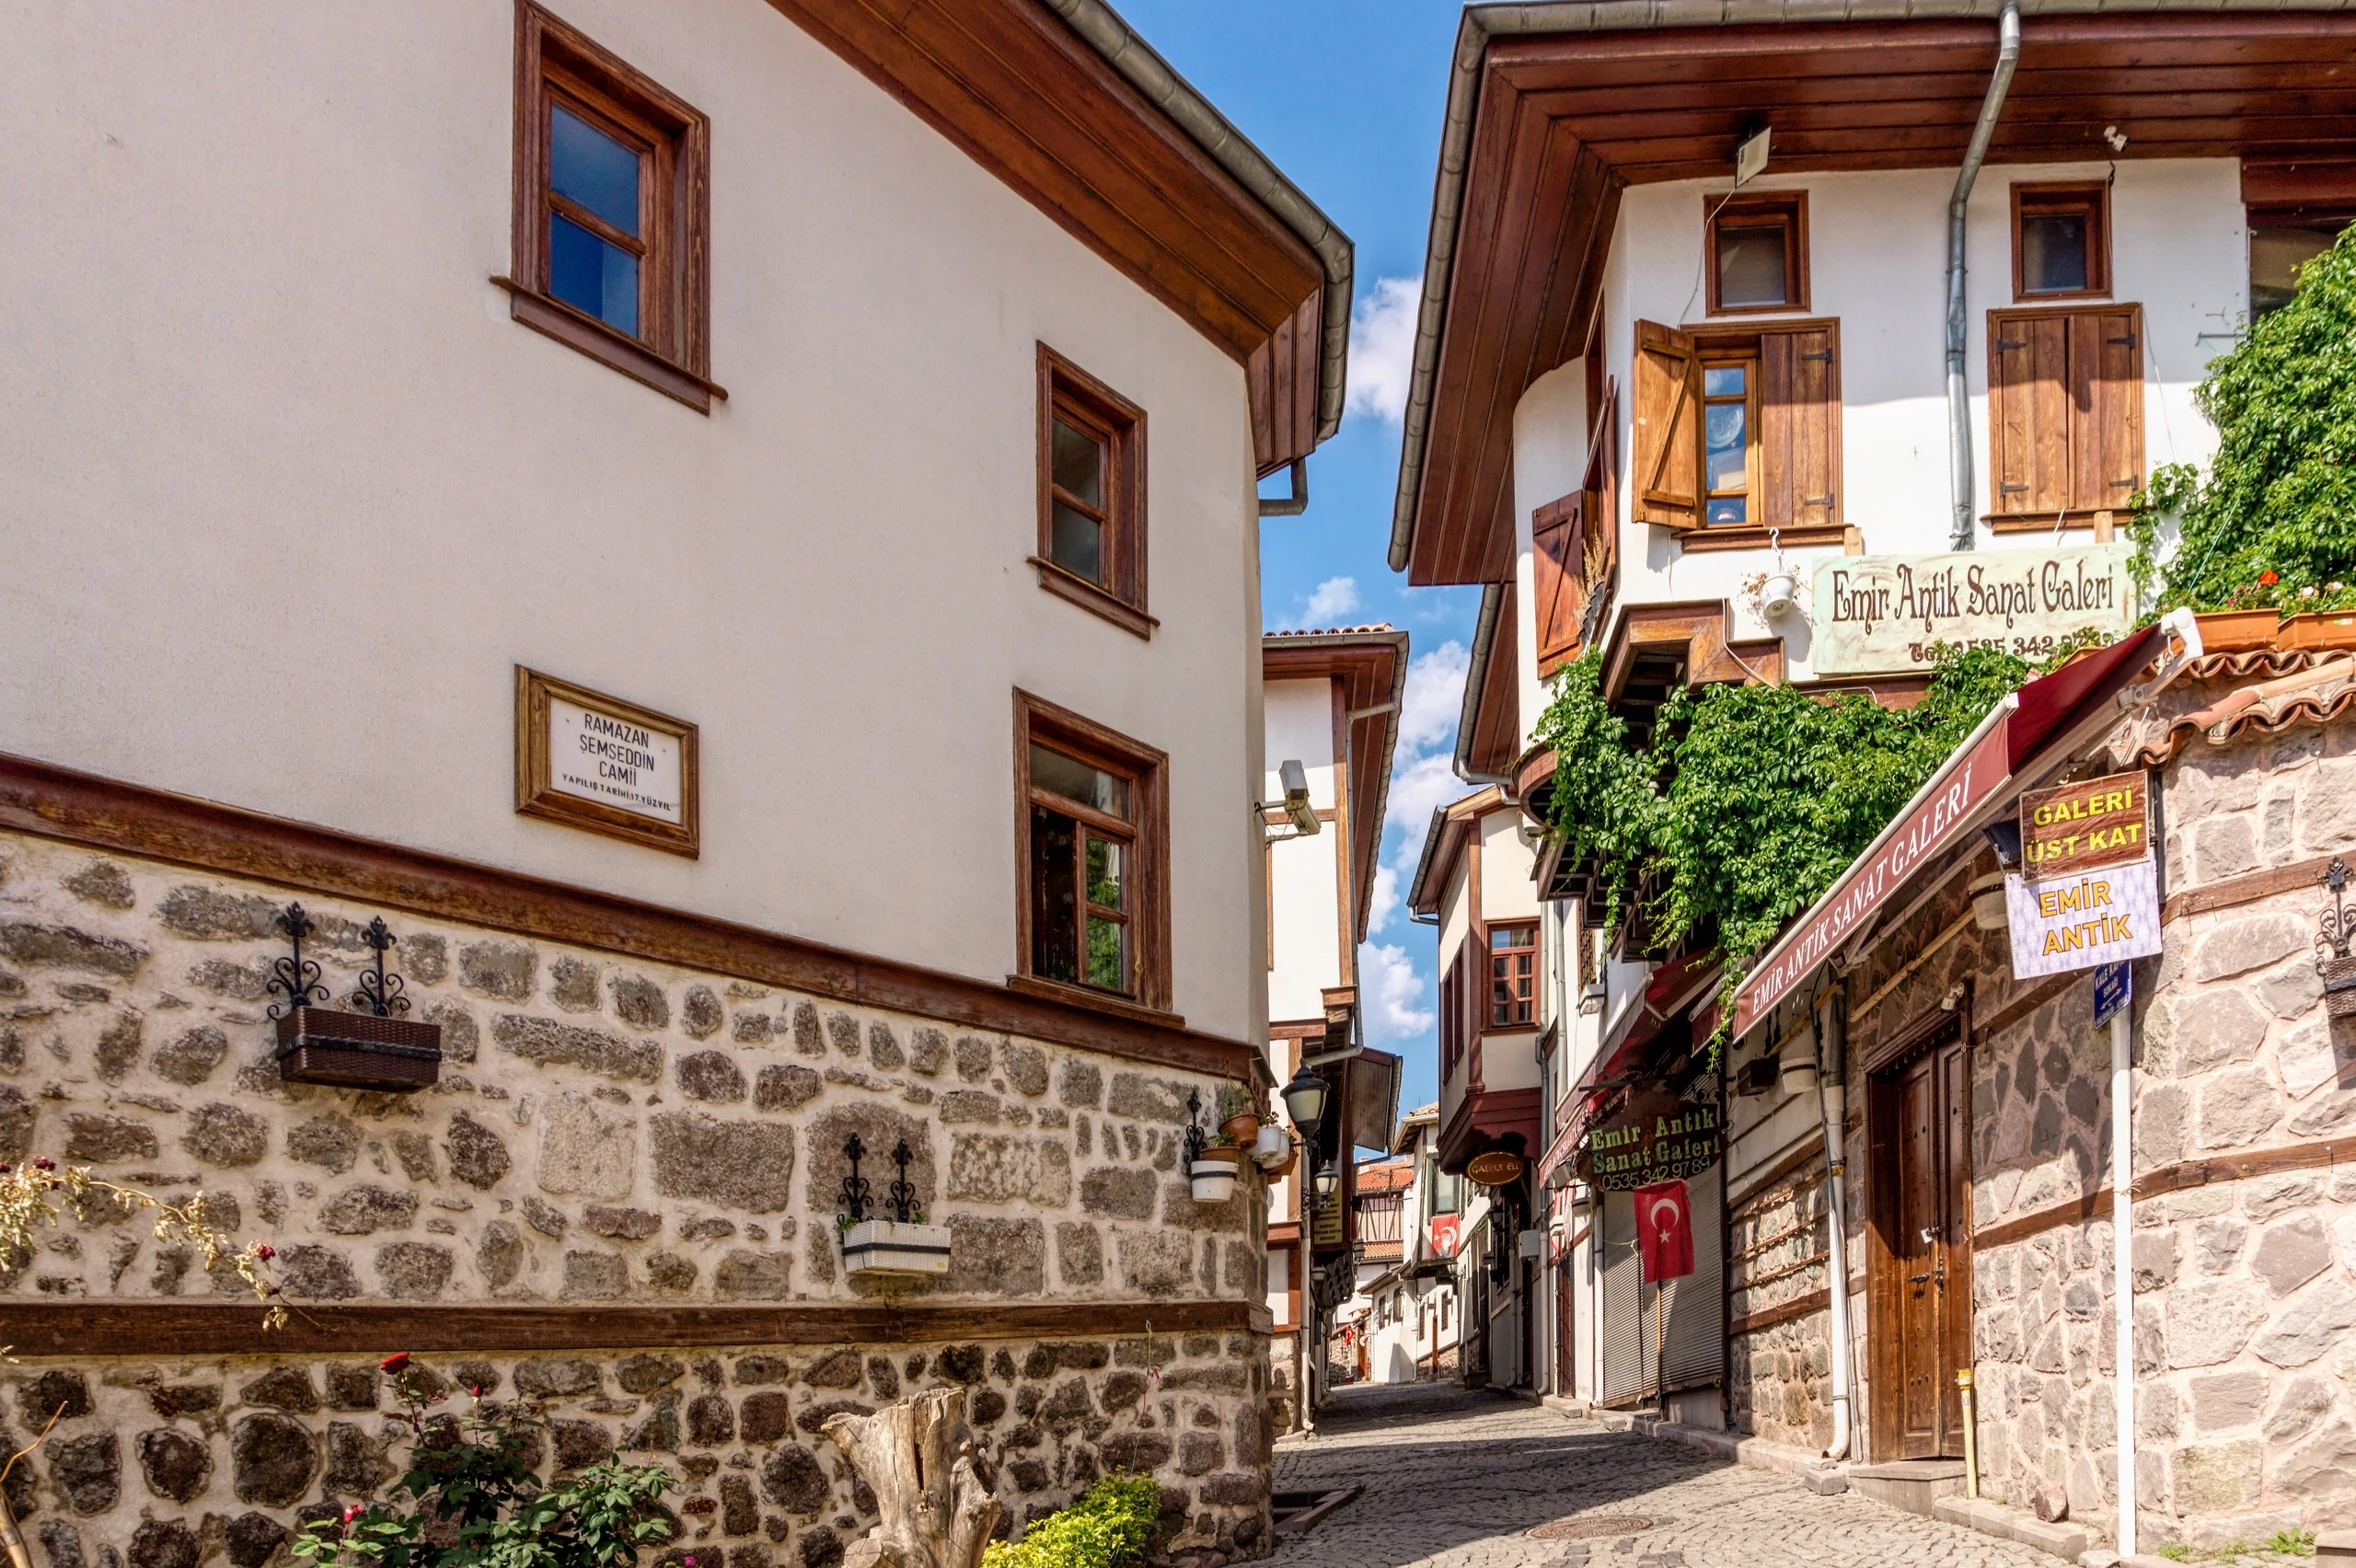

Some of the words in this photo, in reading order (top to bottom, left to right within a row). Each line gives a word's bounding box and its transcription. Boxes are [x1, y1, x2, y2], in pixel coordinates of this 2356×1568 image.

[1832, 570, 1889, 636] Emir
[1894, 563, 1961, 633] Antik
[1967, 563, 2037, 629] Sanat
[2041, 559, 2114, 612] Galeri
[2013, 635, 2053, 656] 342
[584, 713, 649, 748] RAMAZAN
[580, 734, 654, 771] ŞEMSEDDİN
[562, 773, 598, 791] YAPILIŞ
[599, 761, 637, 787] CAMİİ
[2033, 785, 2132, 826] GALERİ
[2027, 835, 2080, 864] ÜST
[2088, 823, 2142, 852] KAT
[1752, 971, 1783, 1016] EMİR
[1784, 917, 1830, 985] ANTİK
[1831, 856, 1888, 940] SANAT
[1891, 762, 1972, 876] GALERİ
[2038, 878, 2113, 918] EMİR
[2042, 912, 2133, 957] ANTİK
[1590, 1124, 1641, 1150] Emir
[1655, 1108, 1715, 1138] Antik
[1593, 1147, 1651, 1174] Sanat
[1656, 1134, 1721, 1163] Galeri
[1602, 1172, 1640, 1191] 0535
[1642, 1165, 1669, 1185] 342
[1671, 1161, 1690, 1178] 97
[1692, 1156, 1710, 1174] 89
